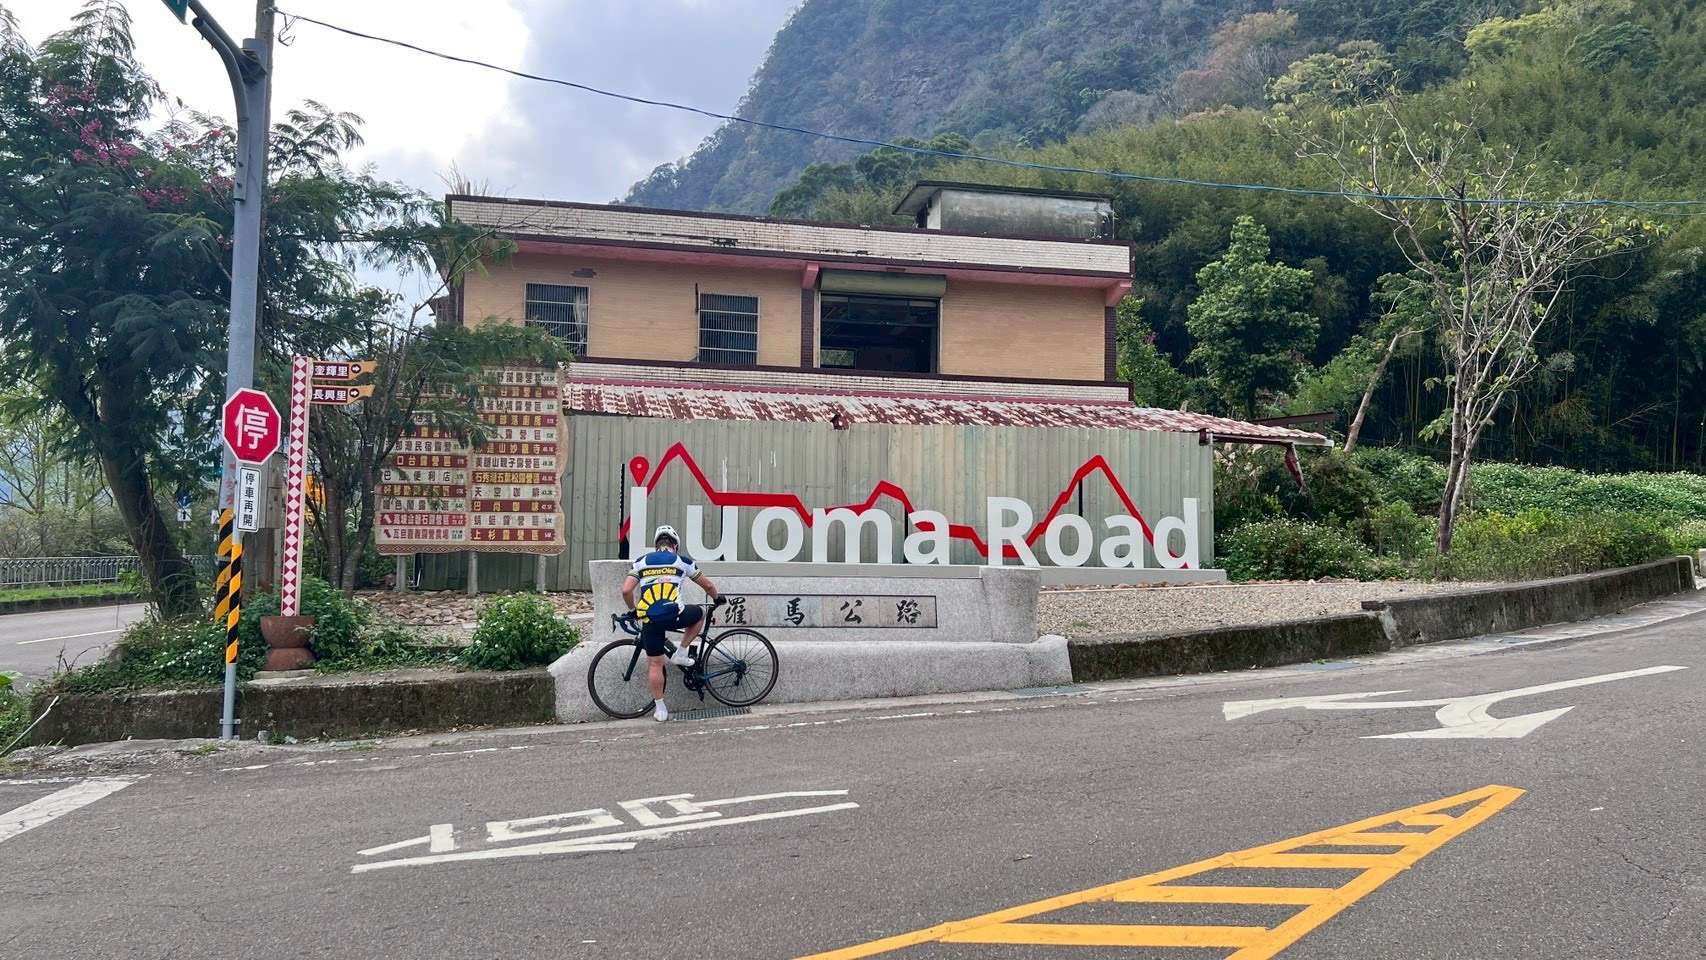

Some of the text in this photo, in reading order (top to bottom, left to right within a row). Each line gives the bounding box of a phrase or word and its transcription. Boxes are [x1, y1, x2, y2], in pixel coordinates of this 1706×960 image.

[315, 365, 348, 377] 奎輝里
[313, 389, 347, 401] 長興里
[235, 403, 269, 449] 停
[384, 470, 451, 481] 巴便利店
[243, 472, 255, 527] 停車再開
[630, 486, 1200, 570] Luoma Road
[724, 596, 922, 626] 羅馬公路
